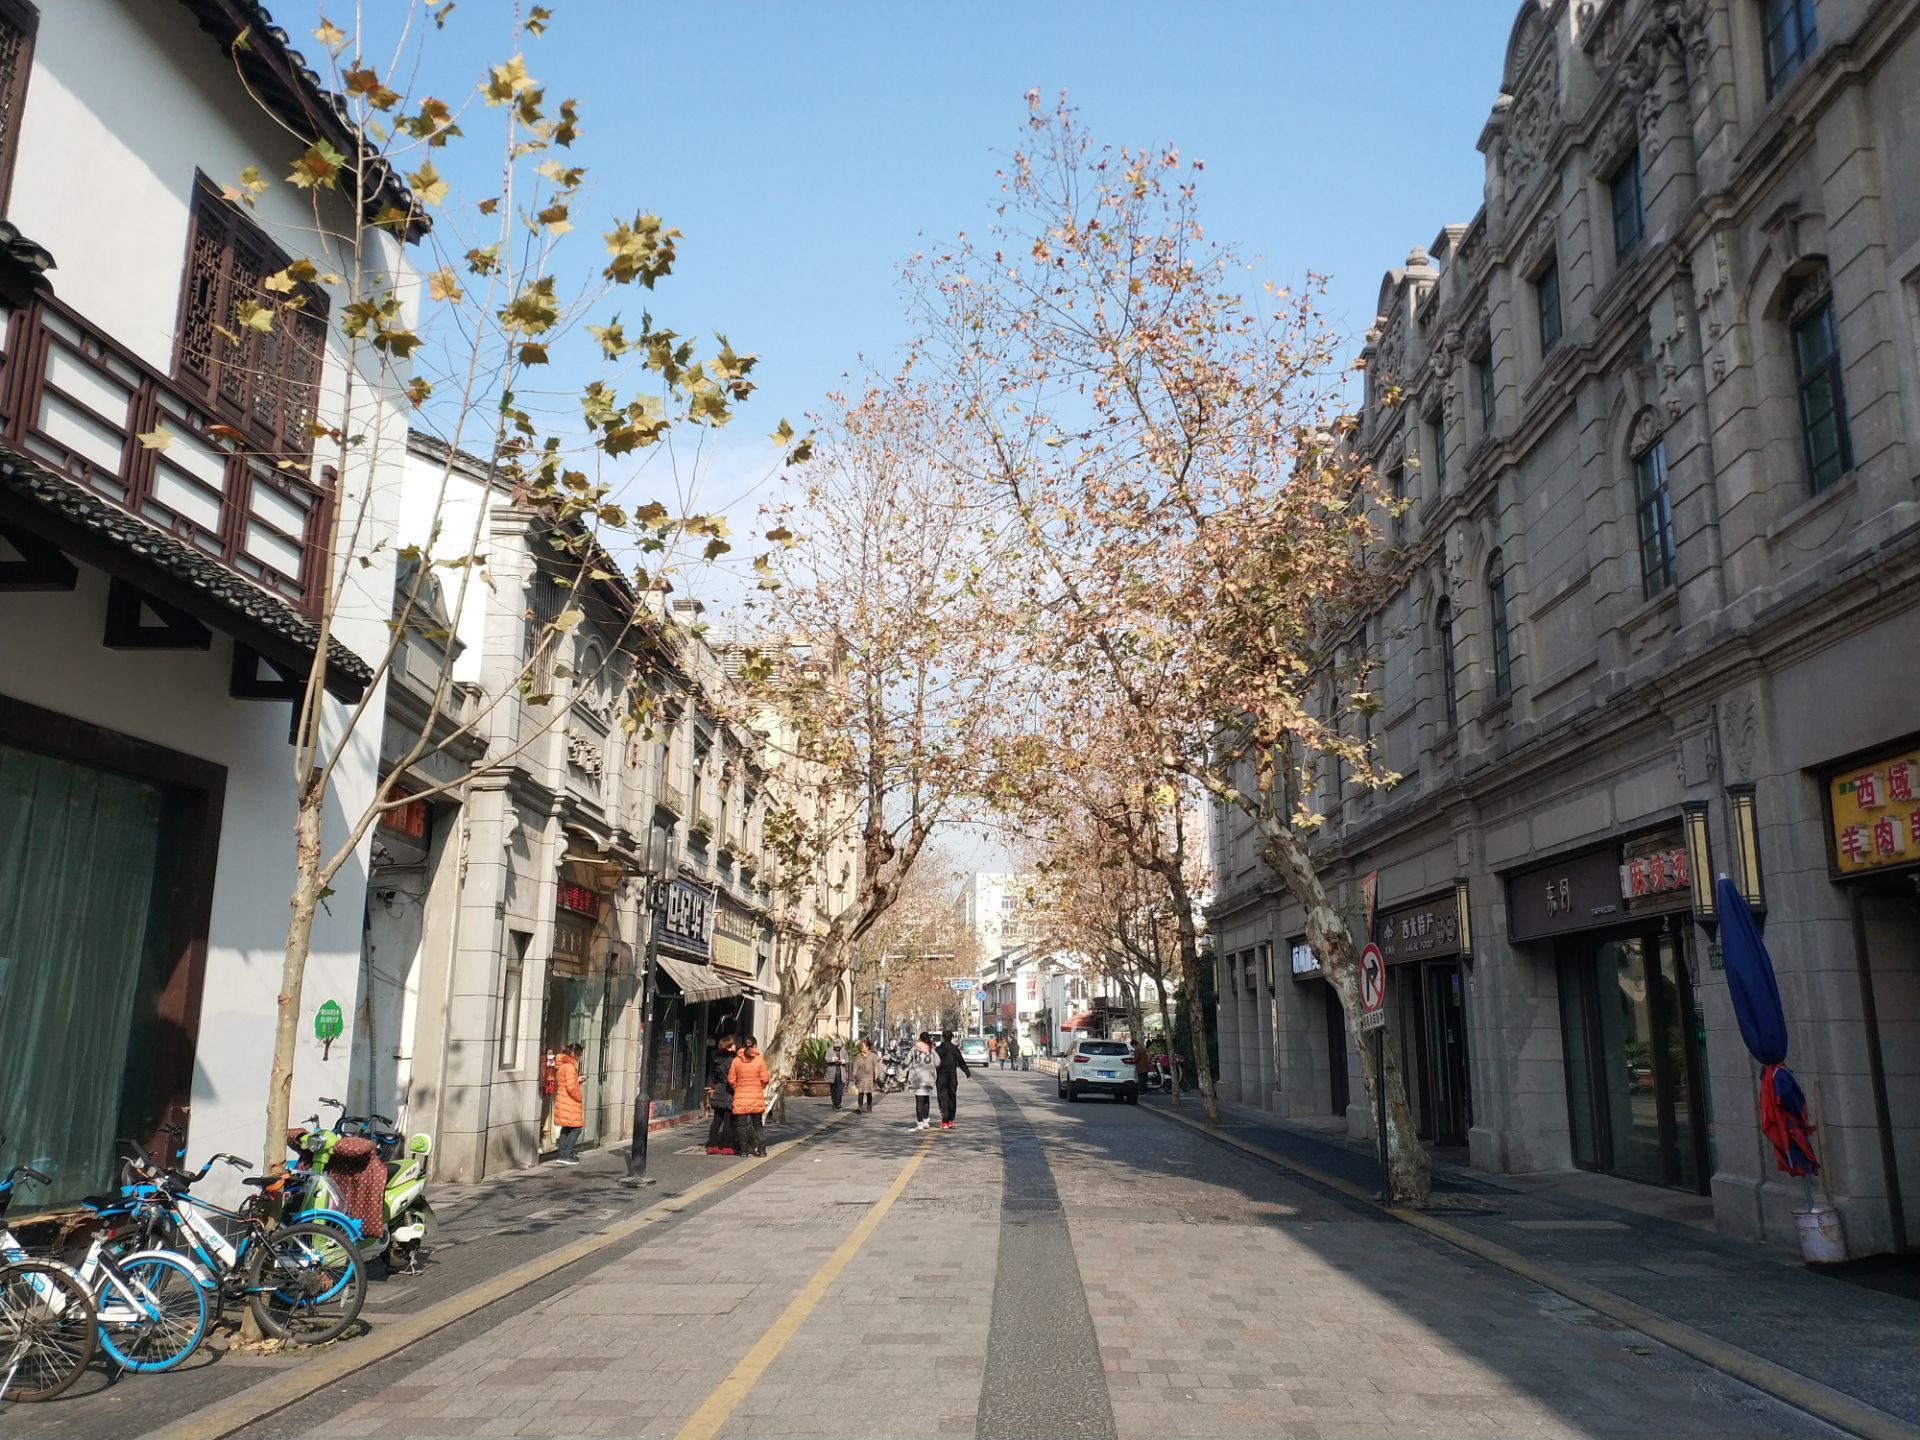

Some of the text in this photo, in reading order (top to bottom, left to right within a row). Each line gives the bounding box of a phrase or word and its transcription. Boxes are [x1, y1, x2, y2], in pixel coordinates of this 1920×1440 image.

[1855, 760, 1912, 810] 西域
[1629, 848, 1690, 896] 麻辣烫
[1401, 913, 1435, 939] 西北特产
